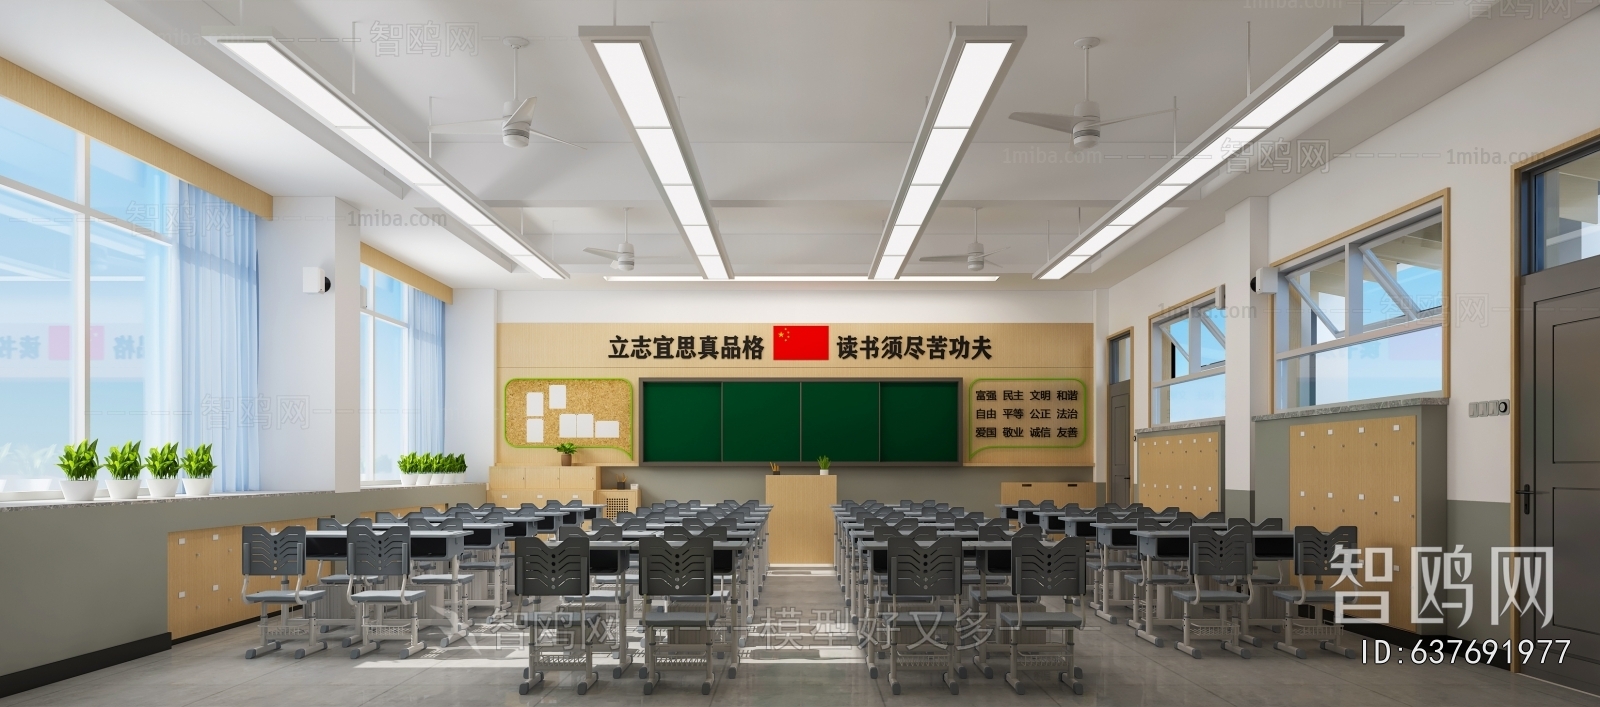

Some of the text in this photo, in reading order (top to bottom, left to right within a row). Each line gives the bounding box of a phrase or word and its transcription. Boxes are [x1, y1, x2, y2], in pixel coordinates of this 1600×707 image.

[607, 335, 993, 361] 立志宜思真品格 读书须尽苦功夫
[975, 390, 1078, 402] 富强 民主 文明 和谐
[975, 408, 1078, 420] 自由 平等 公正 法治
[975, 426, 1078, 438] 爱国 敬业 诚信 友善
